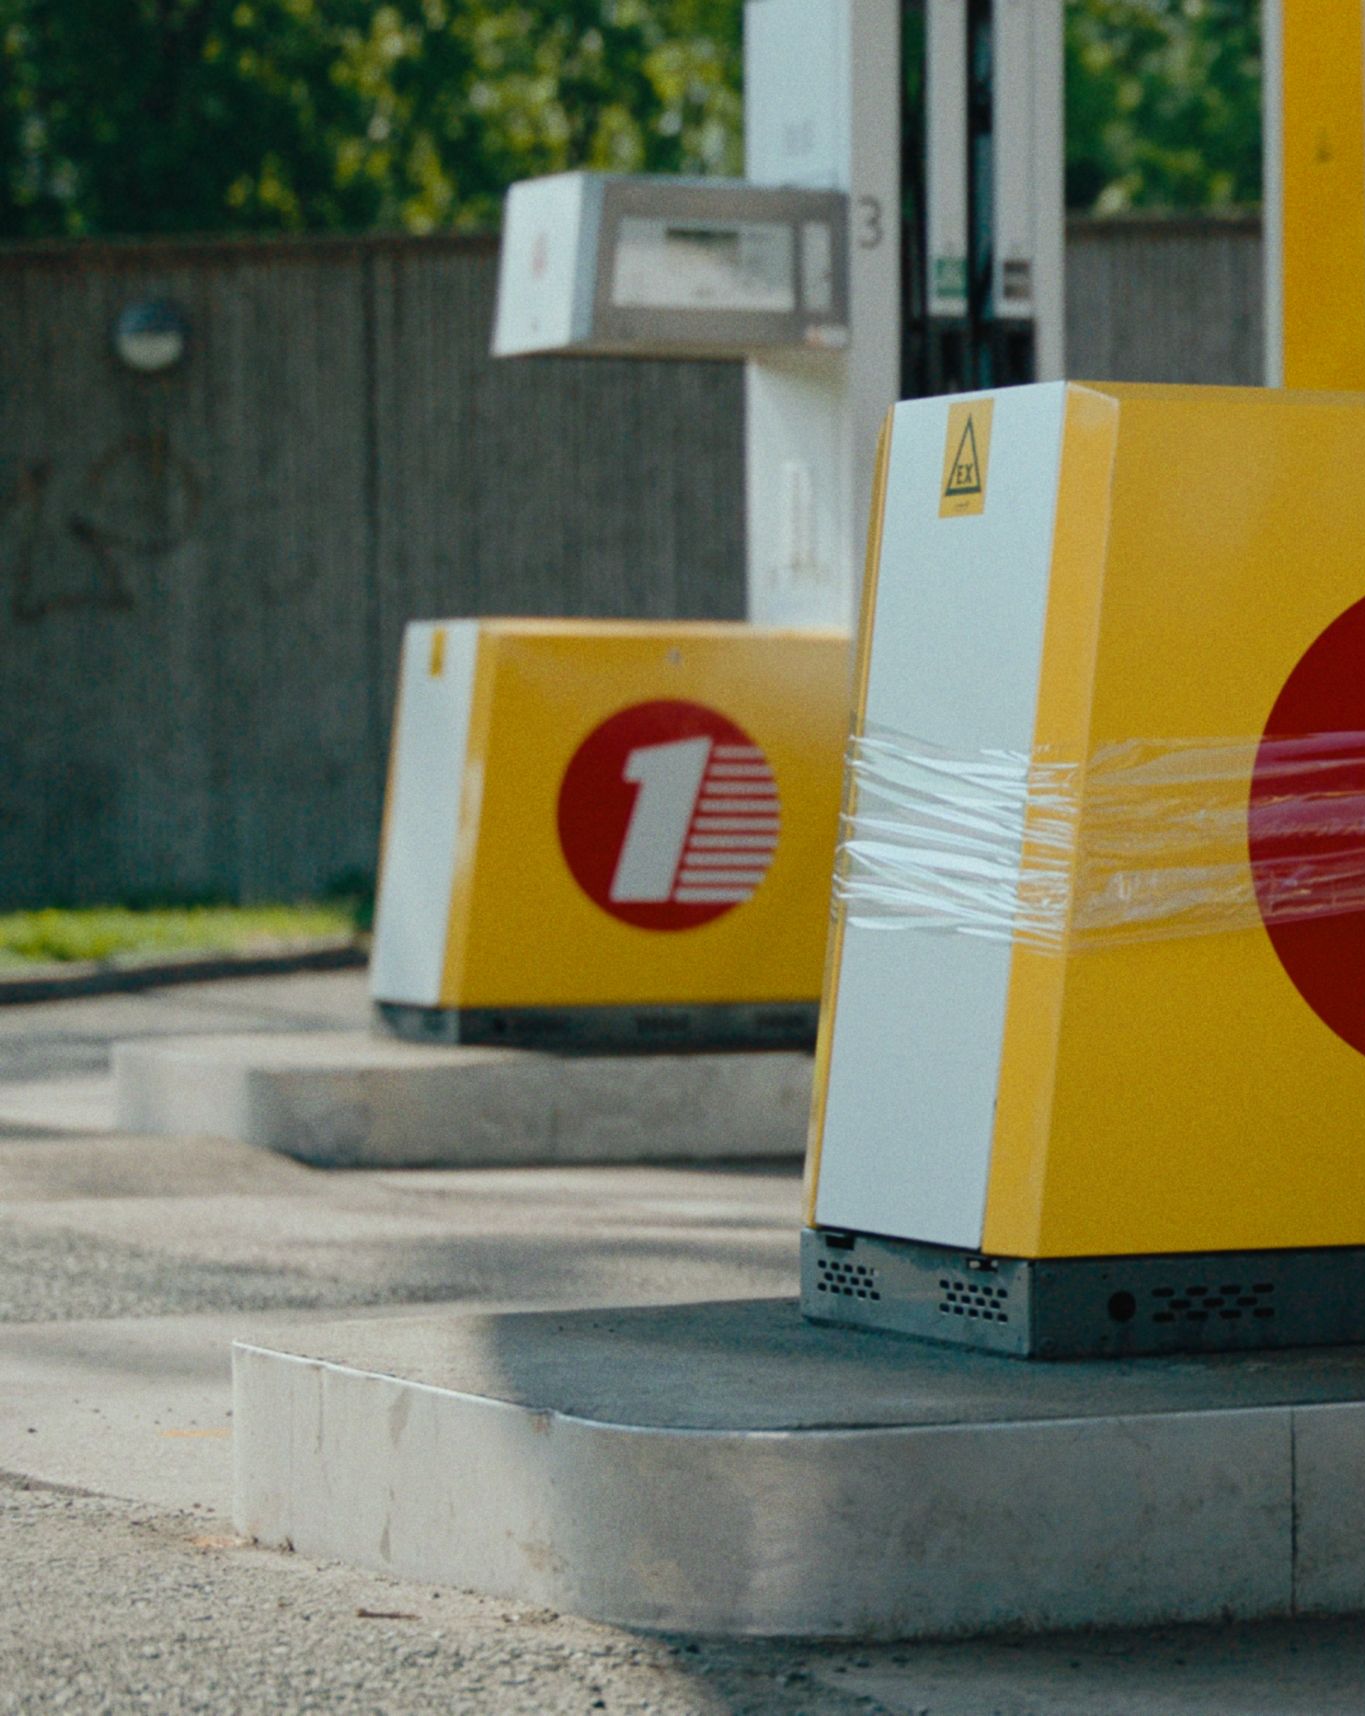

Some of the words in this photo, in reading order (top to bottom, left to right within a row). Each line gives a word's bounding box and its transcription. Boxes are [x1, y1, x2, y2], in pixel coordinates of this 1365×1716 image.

[857, 195, 883, 250] 3
[956, 463, 974, 485] EX
[609, 735, 713, 903] 1
